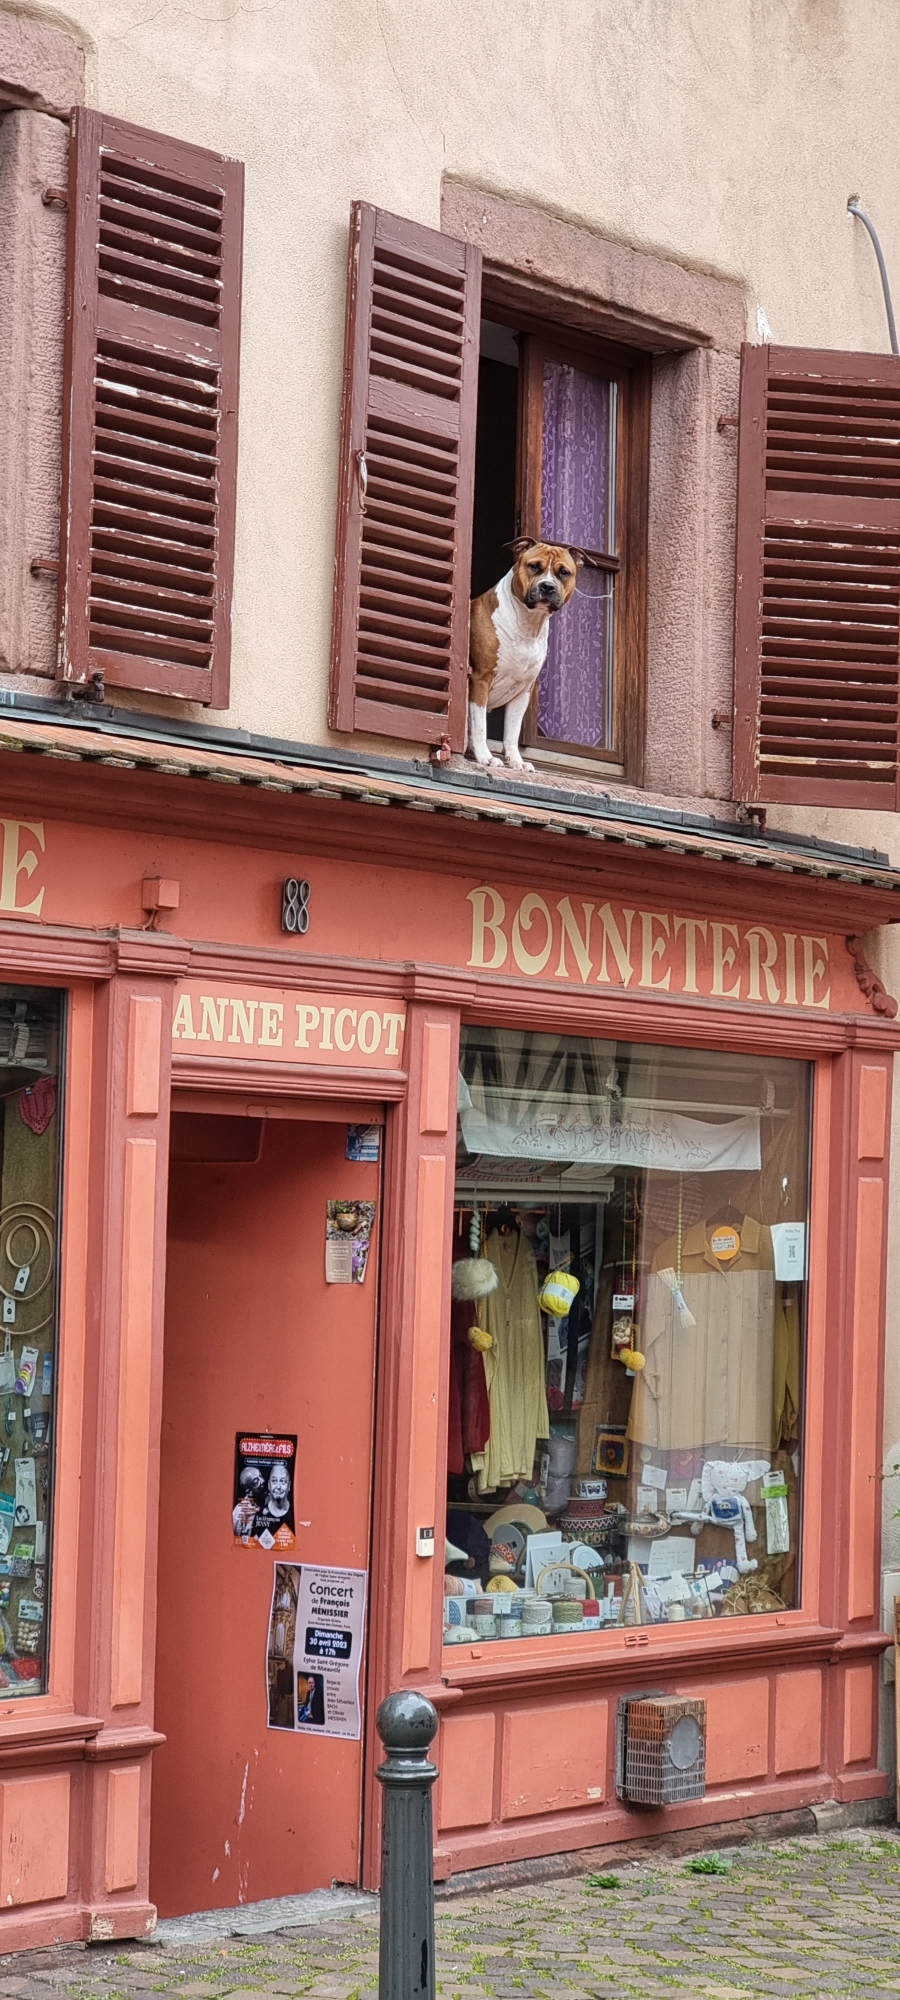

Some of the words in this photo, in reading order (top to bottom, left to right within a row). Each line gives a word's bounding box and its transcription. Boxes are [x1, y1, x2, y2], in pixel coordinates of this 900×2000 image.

[284, 877, 311, 934] 88
[466, 885, 831, 1010] BONNETERIE
[171, 994, 284, 1047] ANNE
[294, 1003, 407, 1056] PICOT
[310, 1582, 354, 1598] Concert
[320, 1597, 350, 1608] François
[311, 1606, 349, 1618] MÉNISSIER
[314, 1630, 343, 1640] Dimanche
[332, 1640, 347, 1649] 2023
[325, 1648, 336, 1656] 17h
